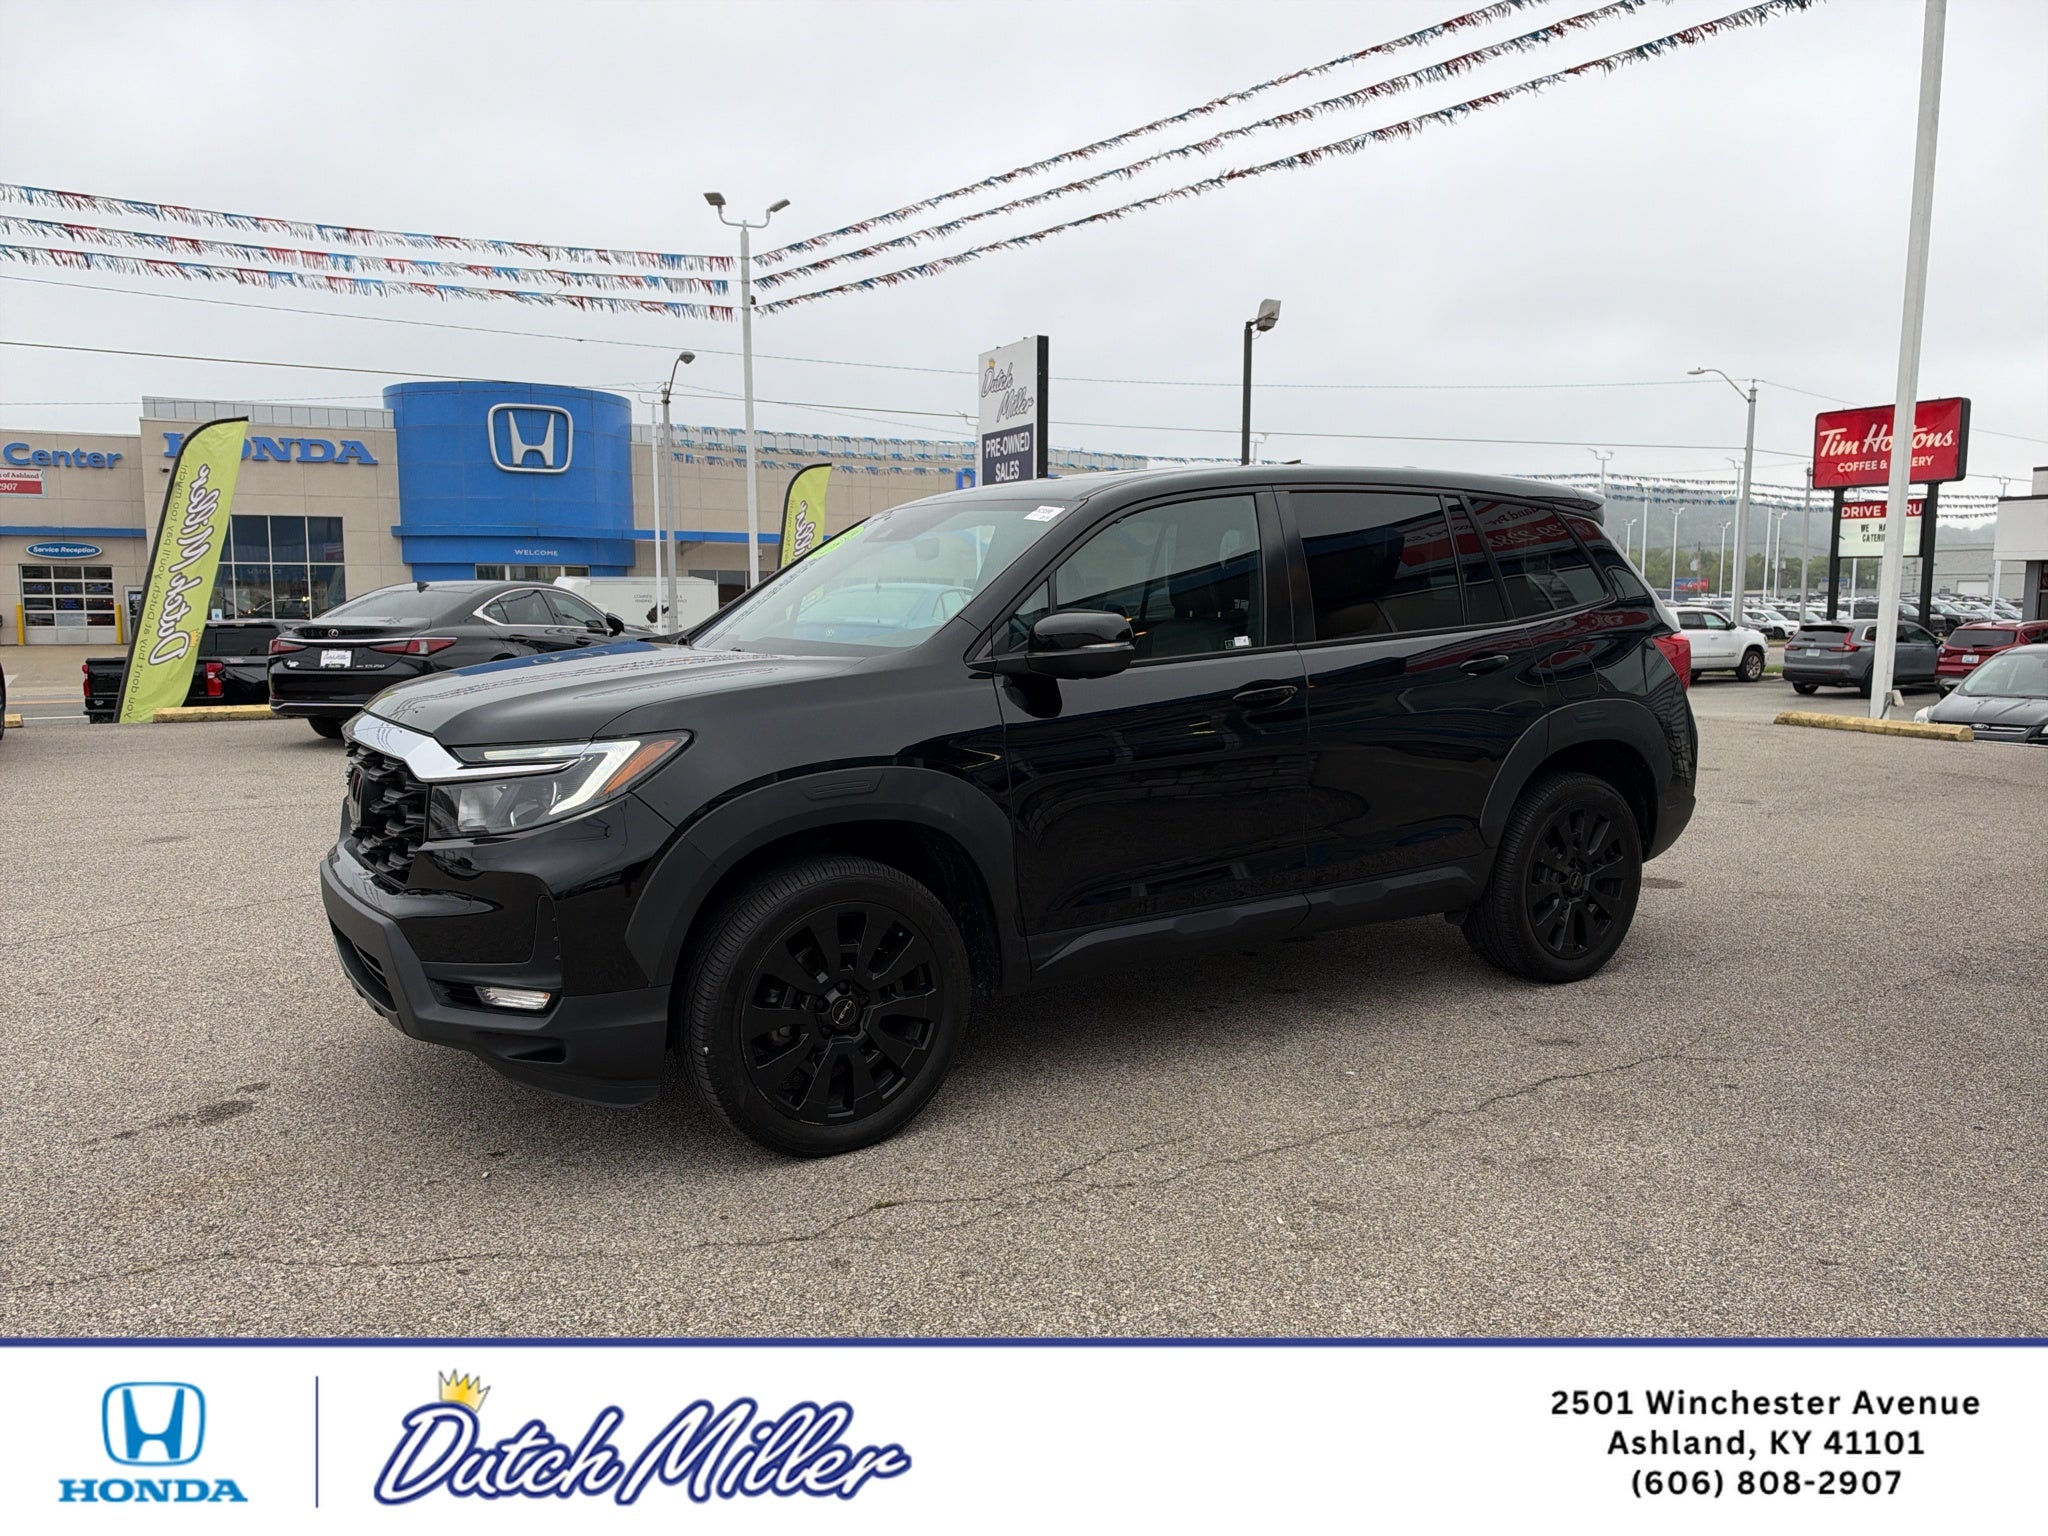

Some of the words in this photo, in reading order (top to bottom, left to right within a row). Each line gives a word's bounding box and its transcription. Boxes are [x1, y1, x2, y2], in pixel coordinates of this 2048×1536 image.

[981, 362, 1013, 398] Dutch
[997, 386, 1034, 423] Miller
[985, 431, 1030, 459] PRE-OWNED
[1819, 427, 1859, 457] Tim
[1862, 423, 1953, 454] Hoons
[3, 442, 122, 469] Center
[1837, 460, 1878, 473] COFFEE
[1879, 460, 1888, 469] &
[995, 460, 1020, 482] SALES
[1841, 504, 1882, 518] DRIVE
[60, 546, 95, 554] Reception
[514, 549, 559, 557] WELCOME
